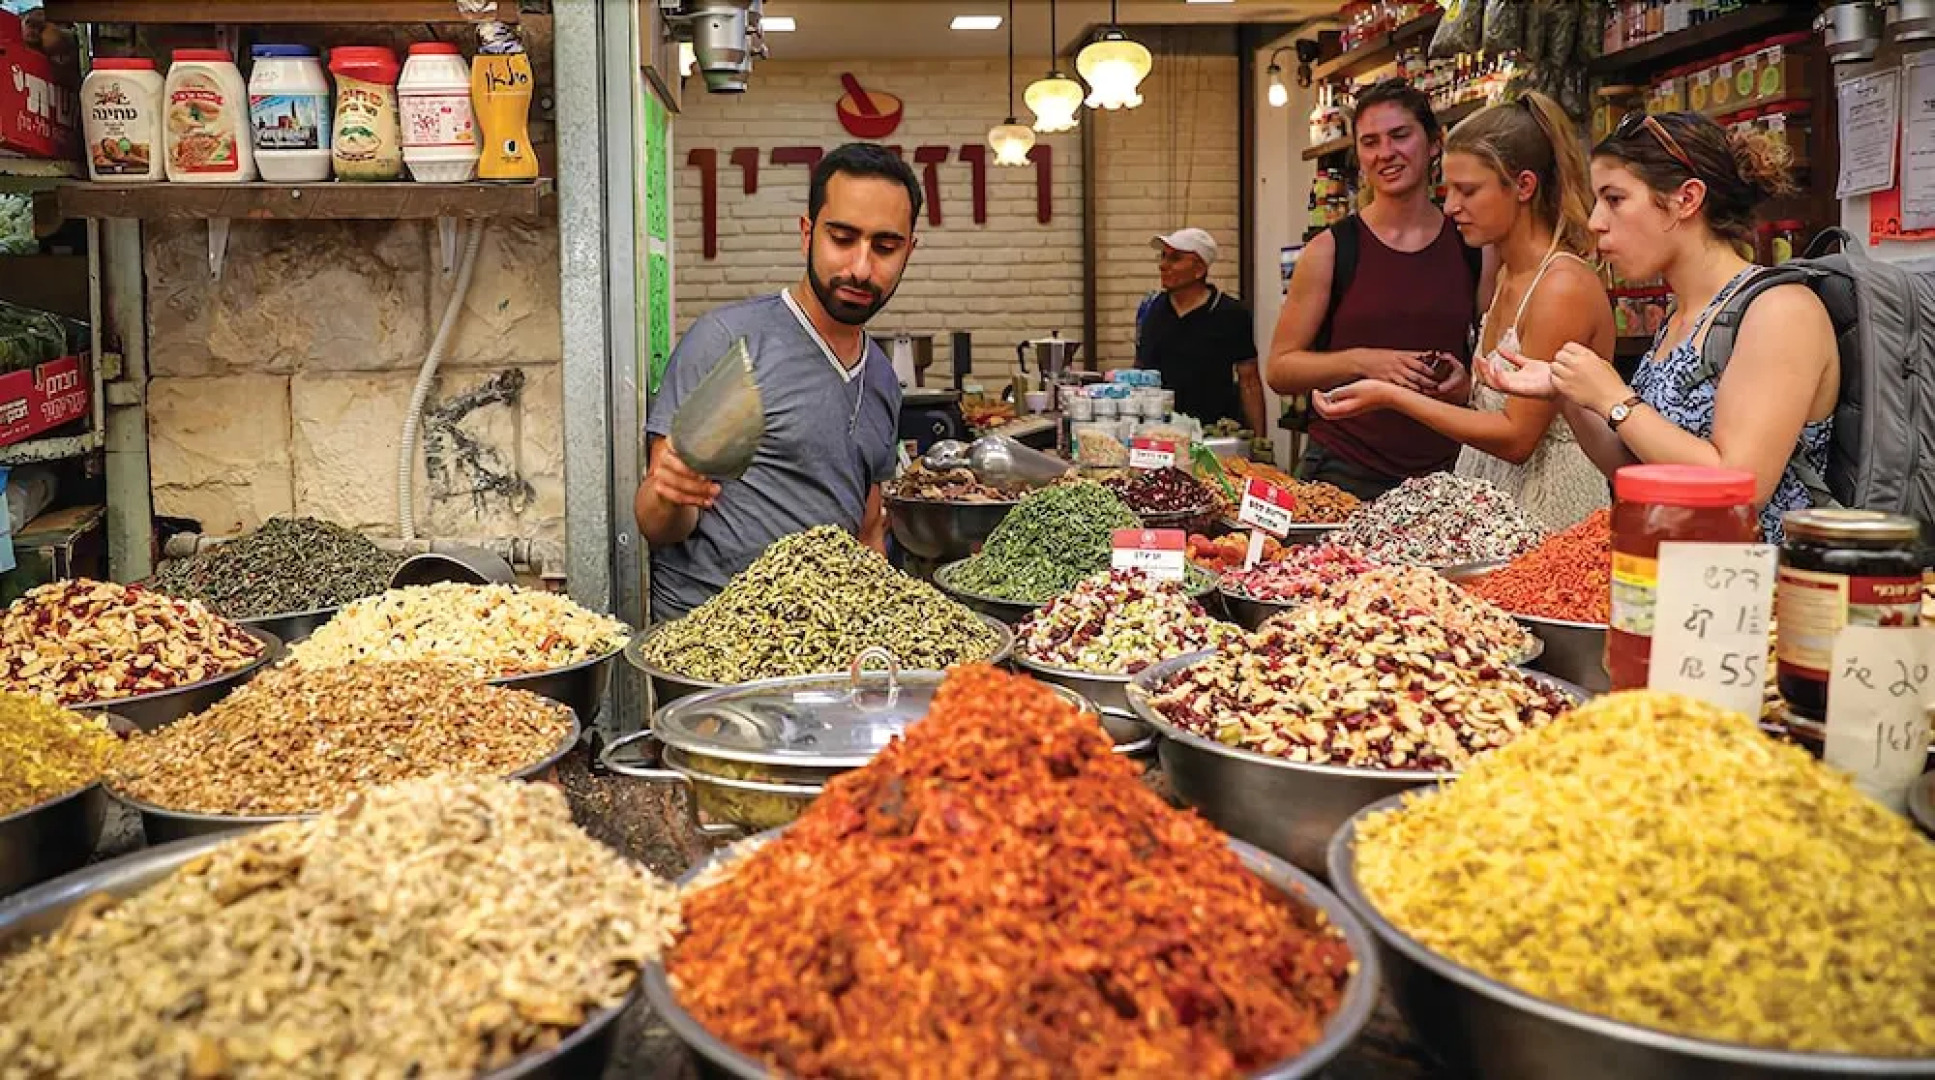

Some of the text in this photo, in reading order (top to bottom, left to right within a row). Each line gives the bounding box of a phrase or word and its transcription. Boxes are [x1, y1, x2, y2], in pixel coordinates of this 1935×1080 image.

[93, 108, 138, 121] טחינה
[687, 144, 1052, 259] רוזרין
[1720, 653, 1761, 687] 55
[1887, 658, 1929, 697] 20
